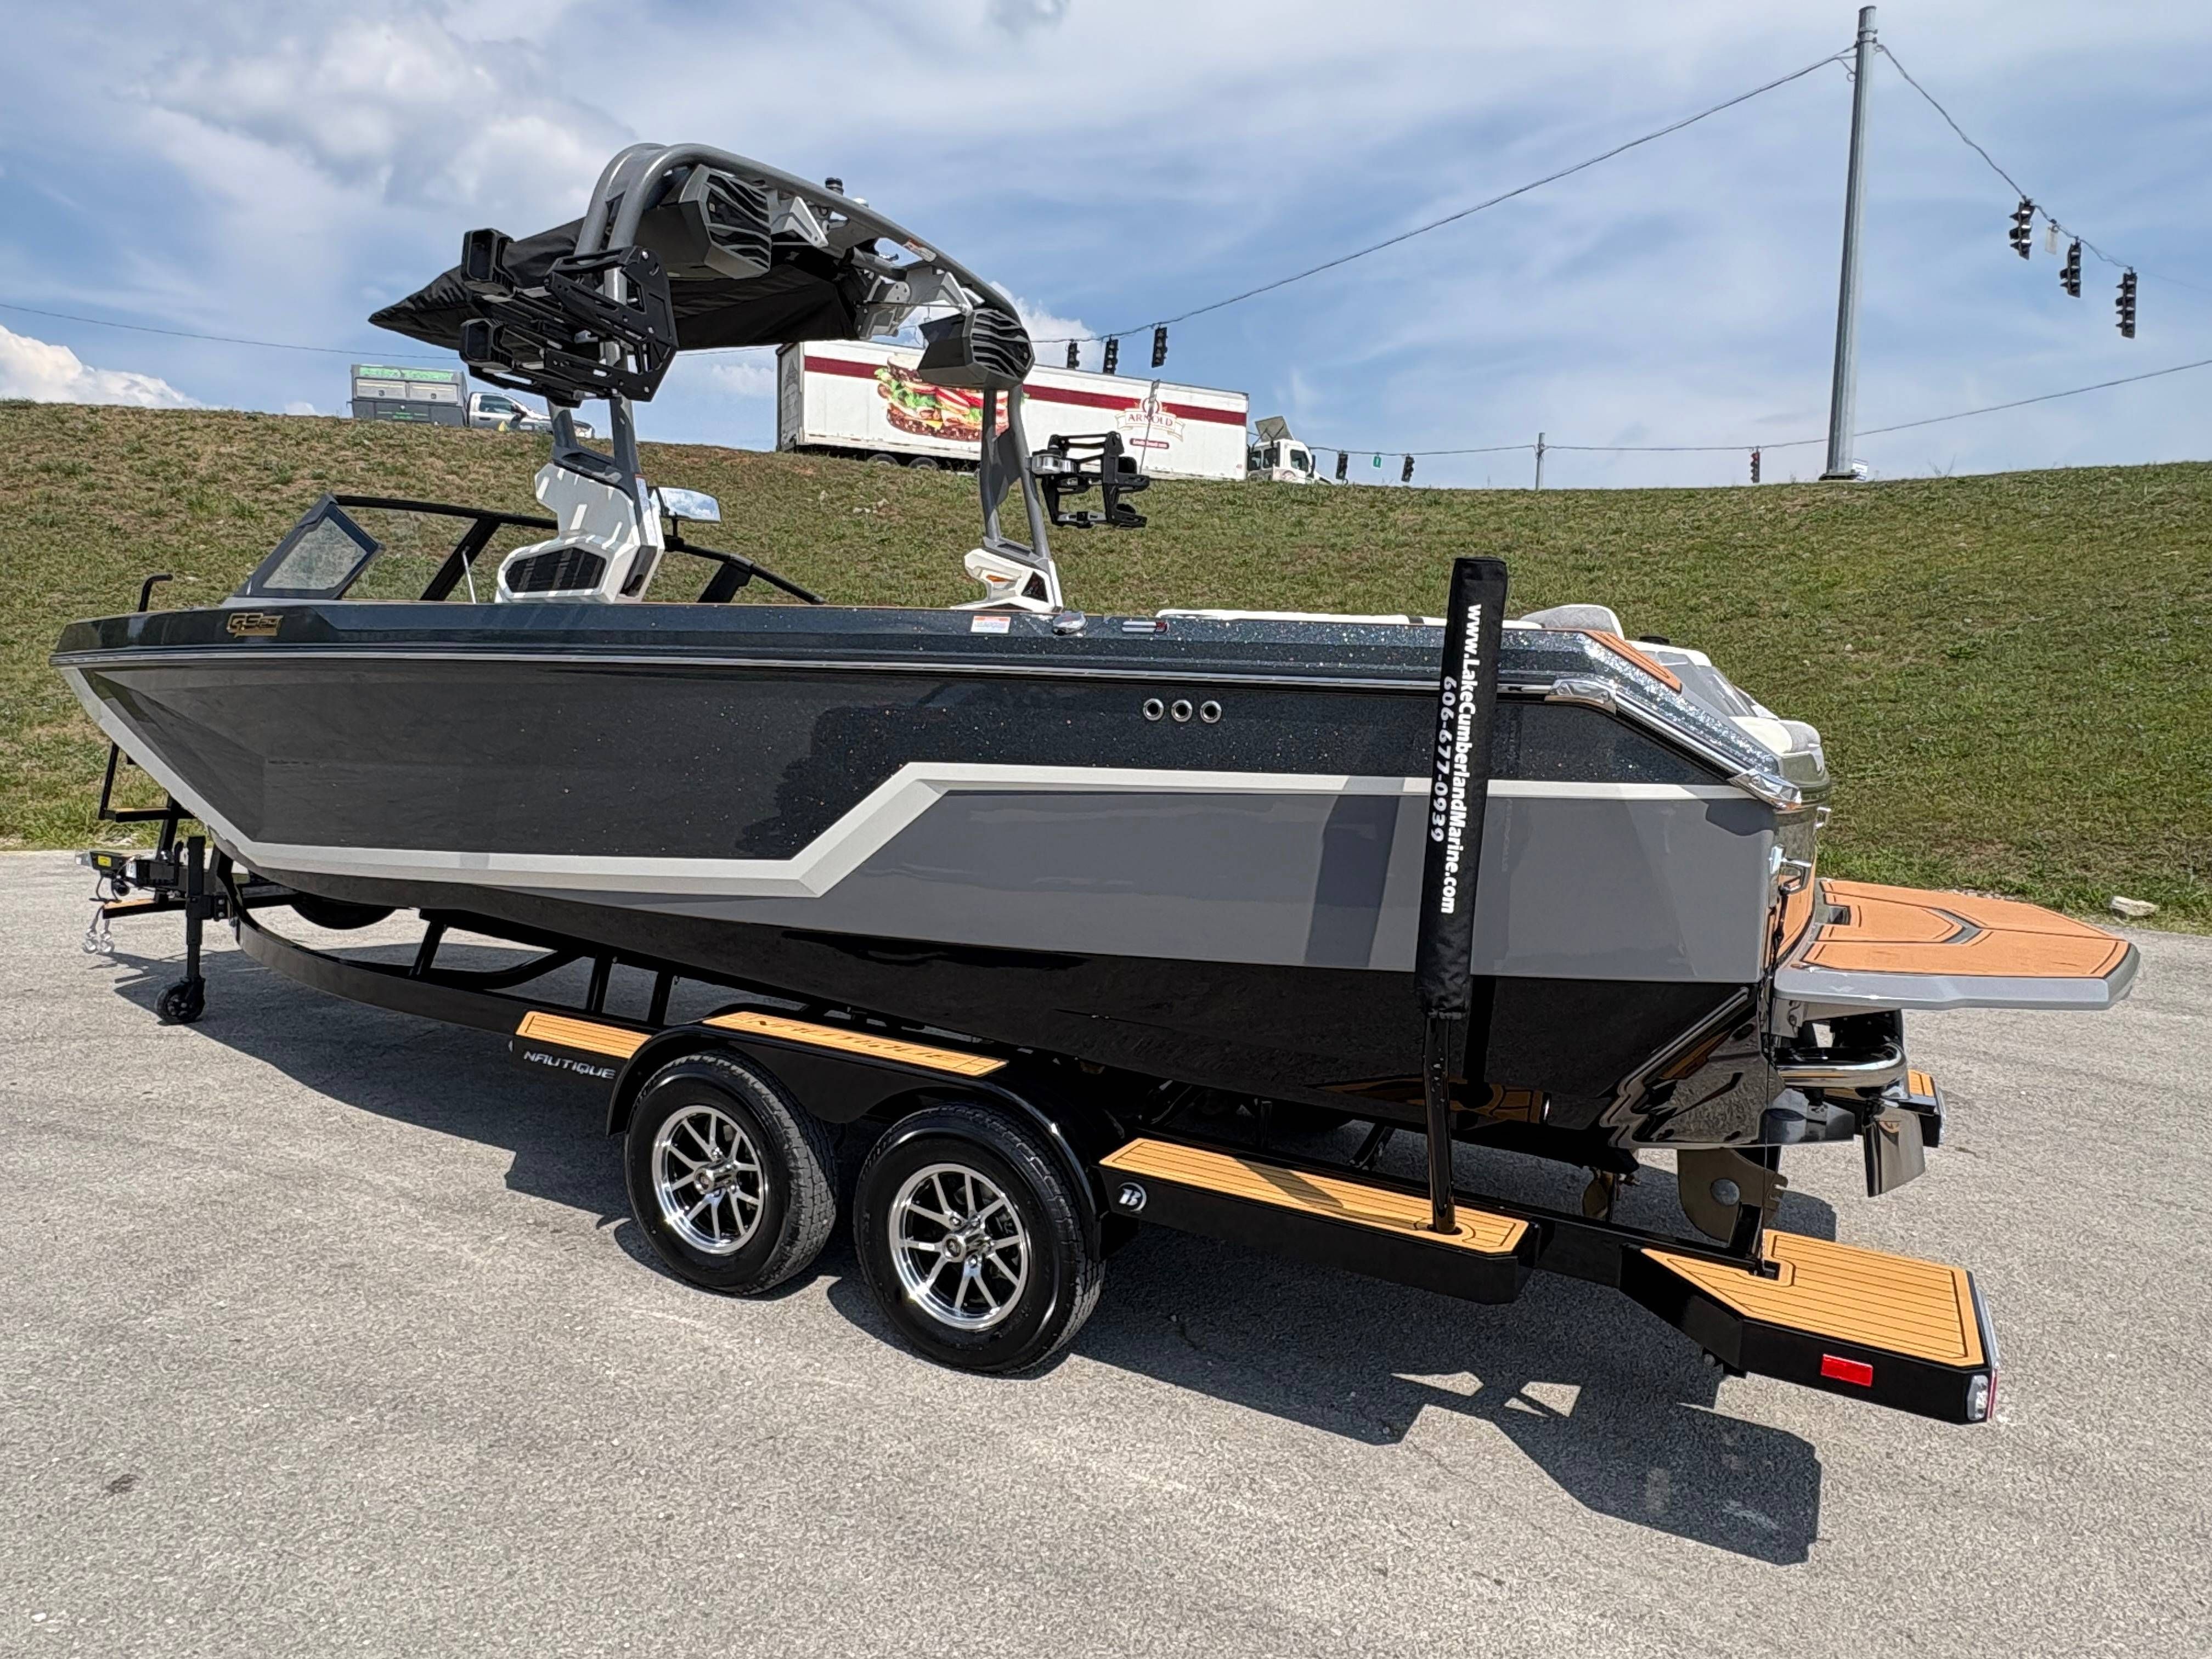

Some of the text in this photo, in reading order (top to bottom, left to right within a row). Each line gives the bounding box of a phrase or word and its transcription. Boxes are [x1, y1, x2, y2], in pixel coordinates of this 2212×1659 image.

[1430, 676, 1457, 842] 606-677-0939
[1441, 604, 1482, 913] www.LakeCumberlandMarine.com
[523, 1051, 616, 1080] NAUTIQUE
